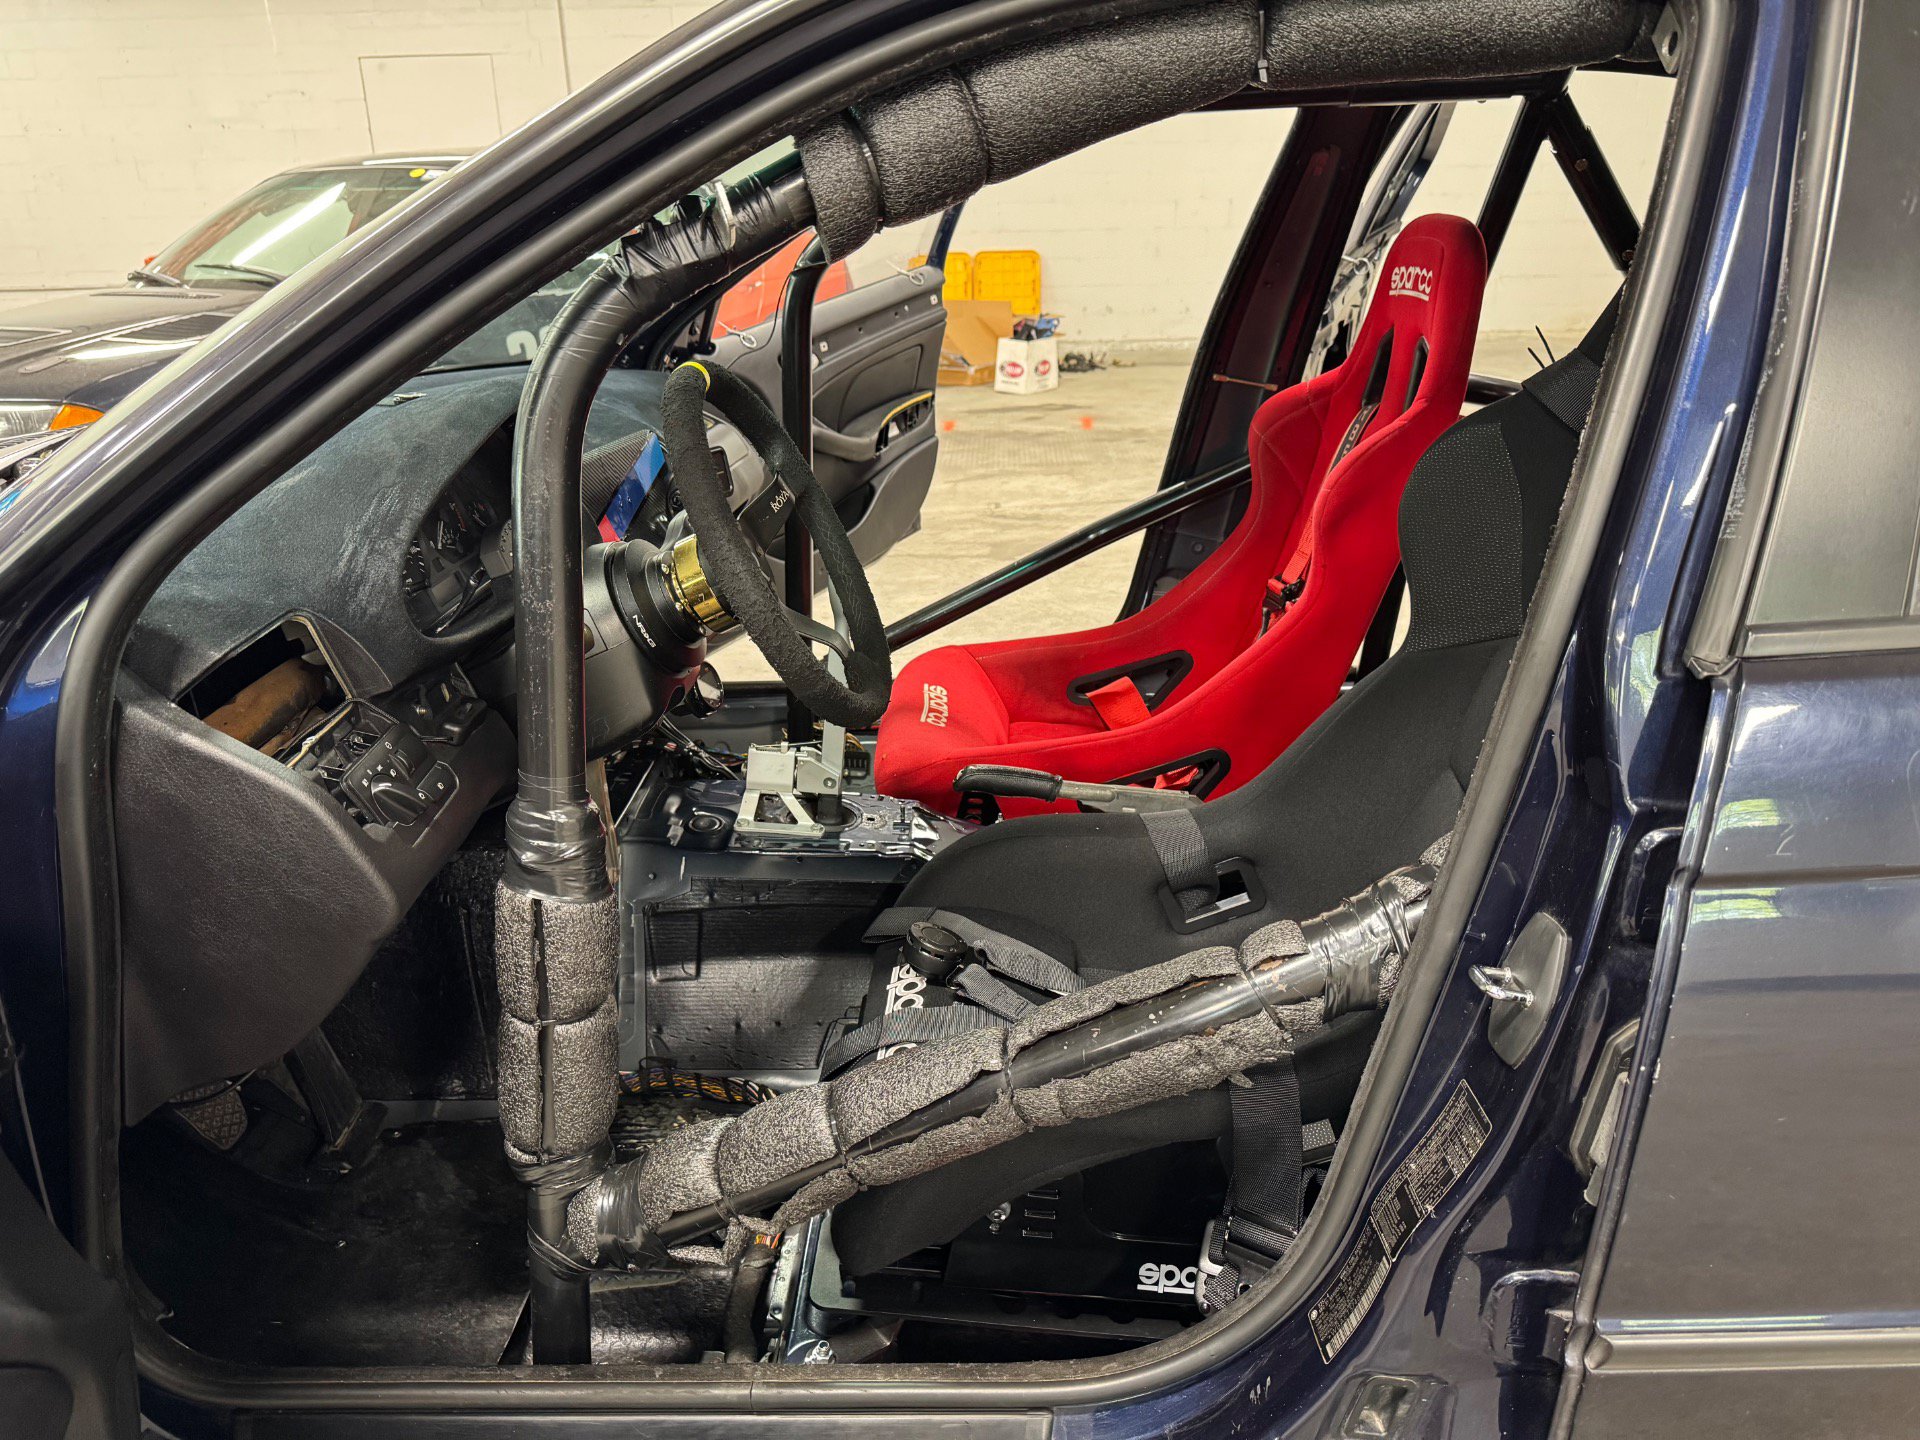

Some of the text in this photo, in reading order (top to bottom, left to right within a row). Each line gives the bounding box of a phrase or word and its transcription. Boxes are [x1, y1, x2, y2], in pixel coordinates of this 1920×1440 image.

[1390, 265, 1433, 299] sparco
[769, 489, 791, 513] ROYA
[921, 683, 949, 727] sparco
[1138, 1262, 1199, 1294] spa
